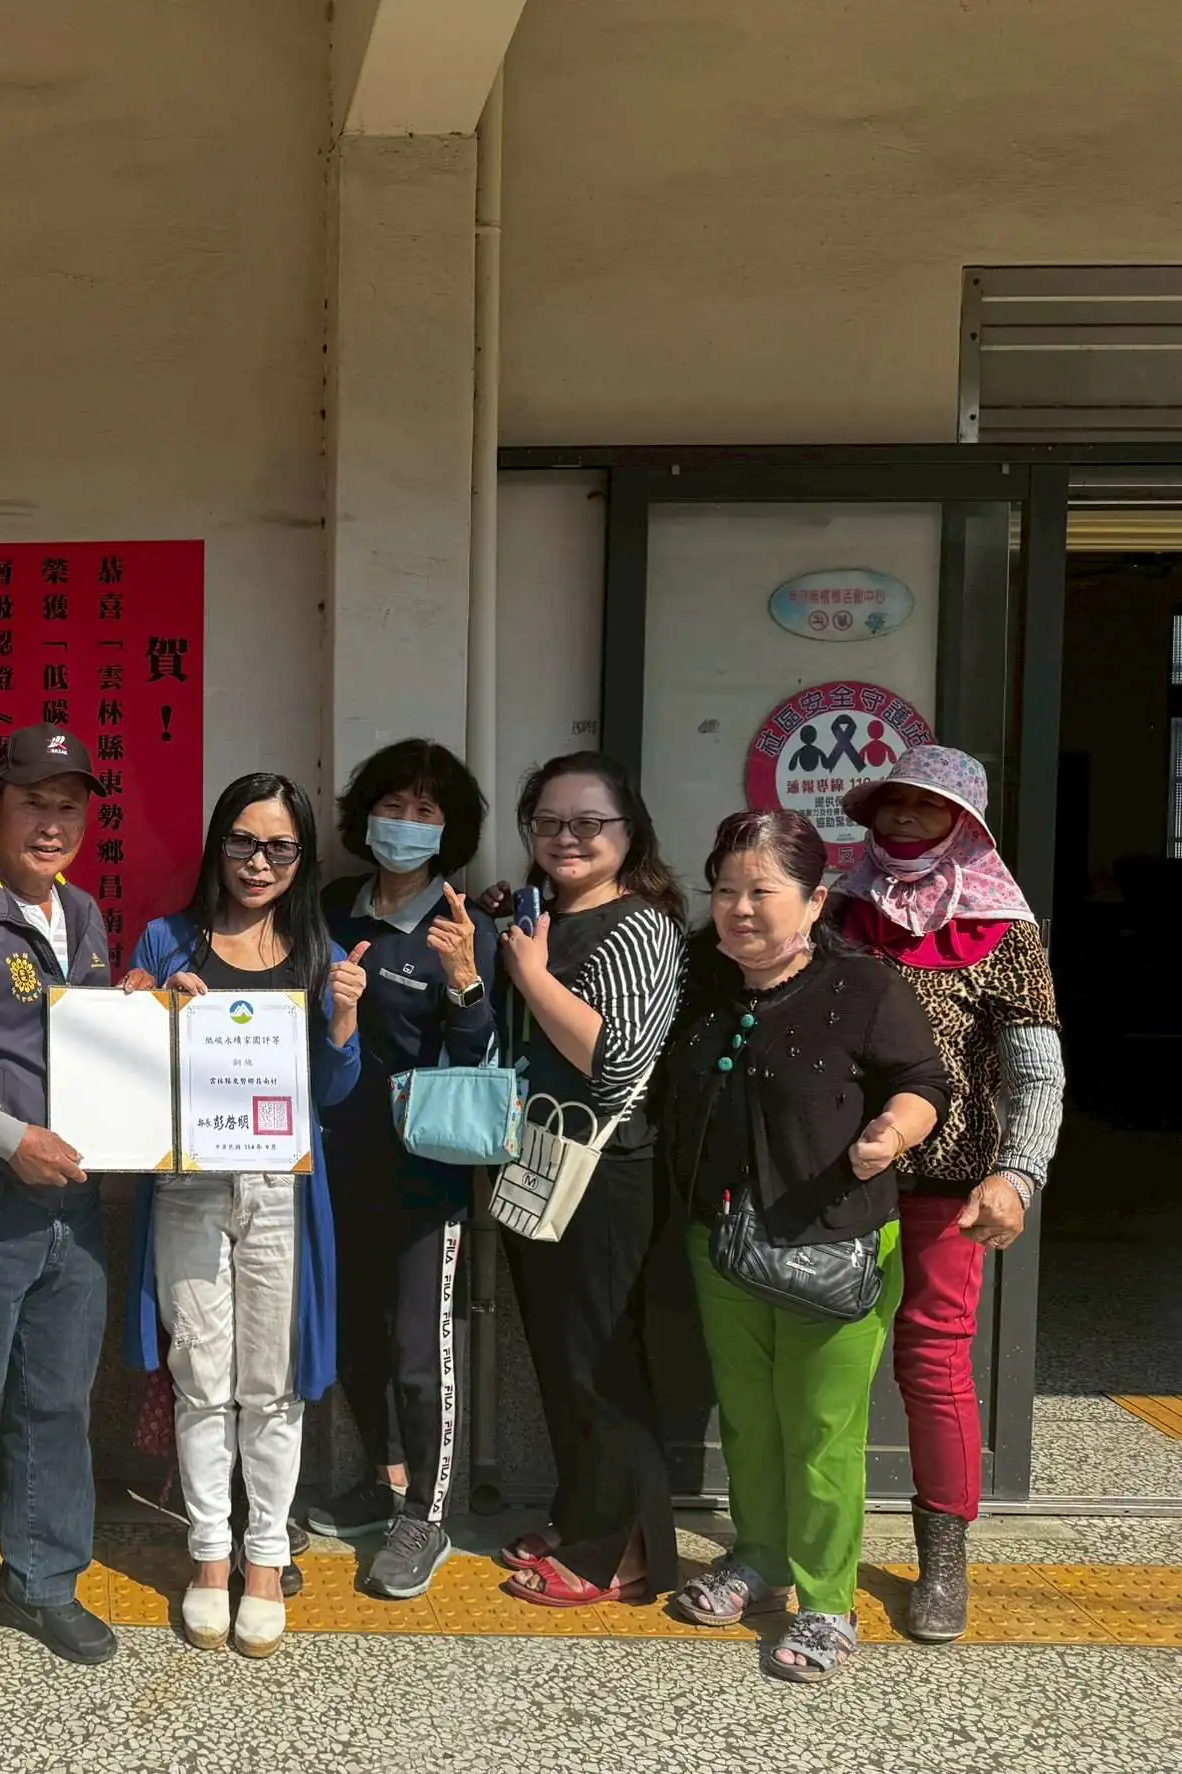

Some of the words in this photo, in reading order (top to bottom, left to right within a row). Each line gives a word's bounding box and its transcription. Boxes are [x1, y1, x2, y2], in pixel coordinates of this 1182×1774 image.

[756, 685, 932, 757] 社區安全守護站
[445, 1238, 457, 1263] FILA
[443, 1274, 453, 1300] FILA
[442, 1311, 452, 1338] FILA
[442, 1347, 452, 1375] FILA
[444, 1385, 454, 1411] FILA
[443, 1420, 453, 1447] FILA
[440, 1456, 452, 1481] FILA
